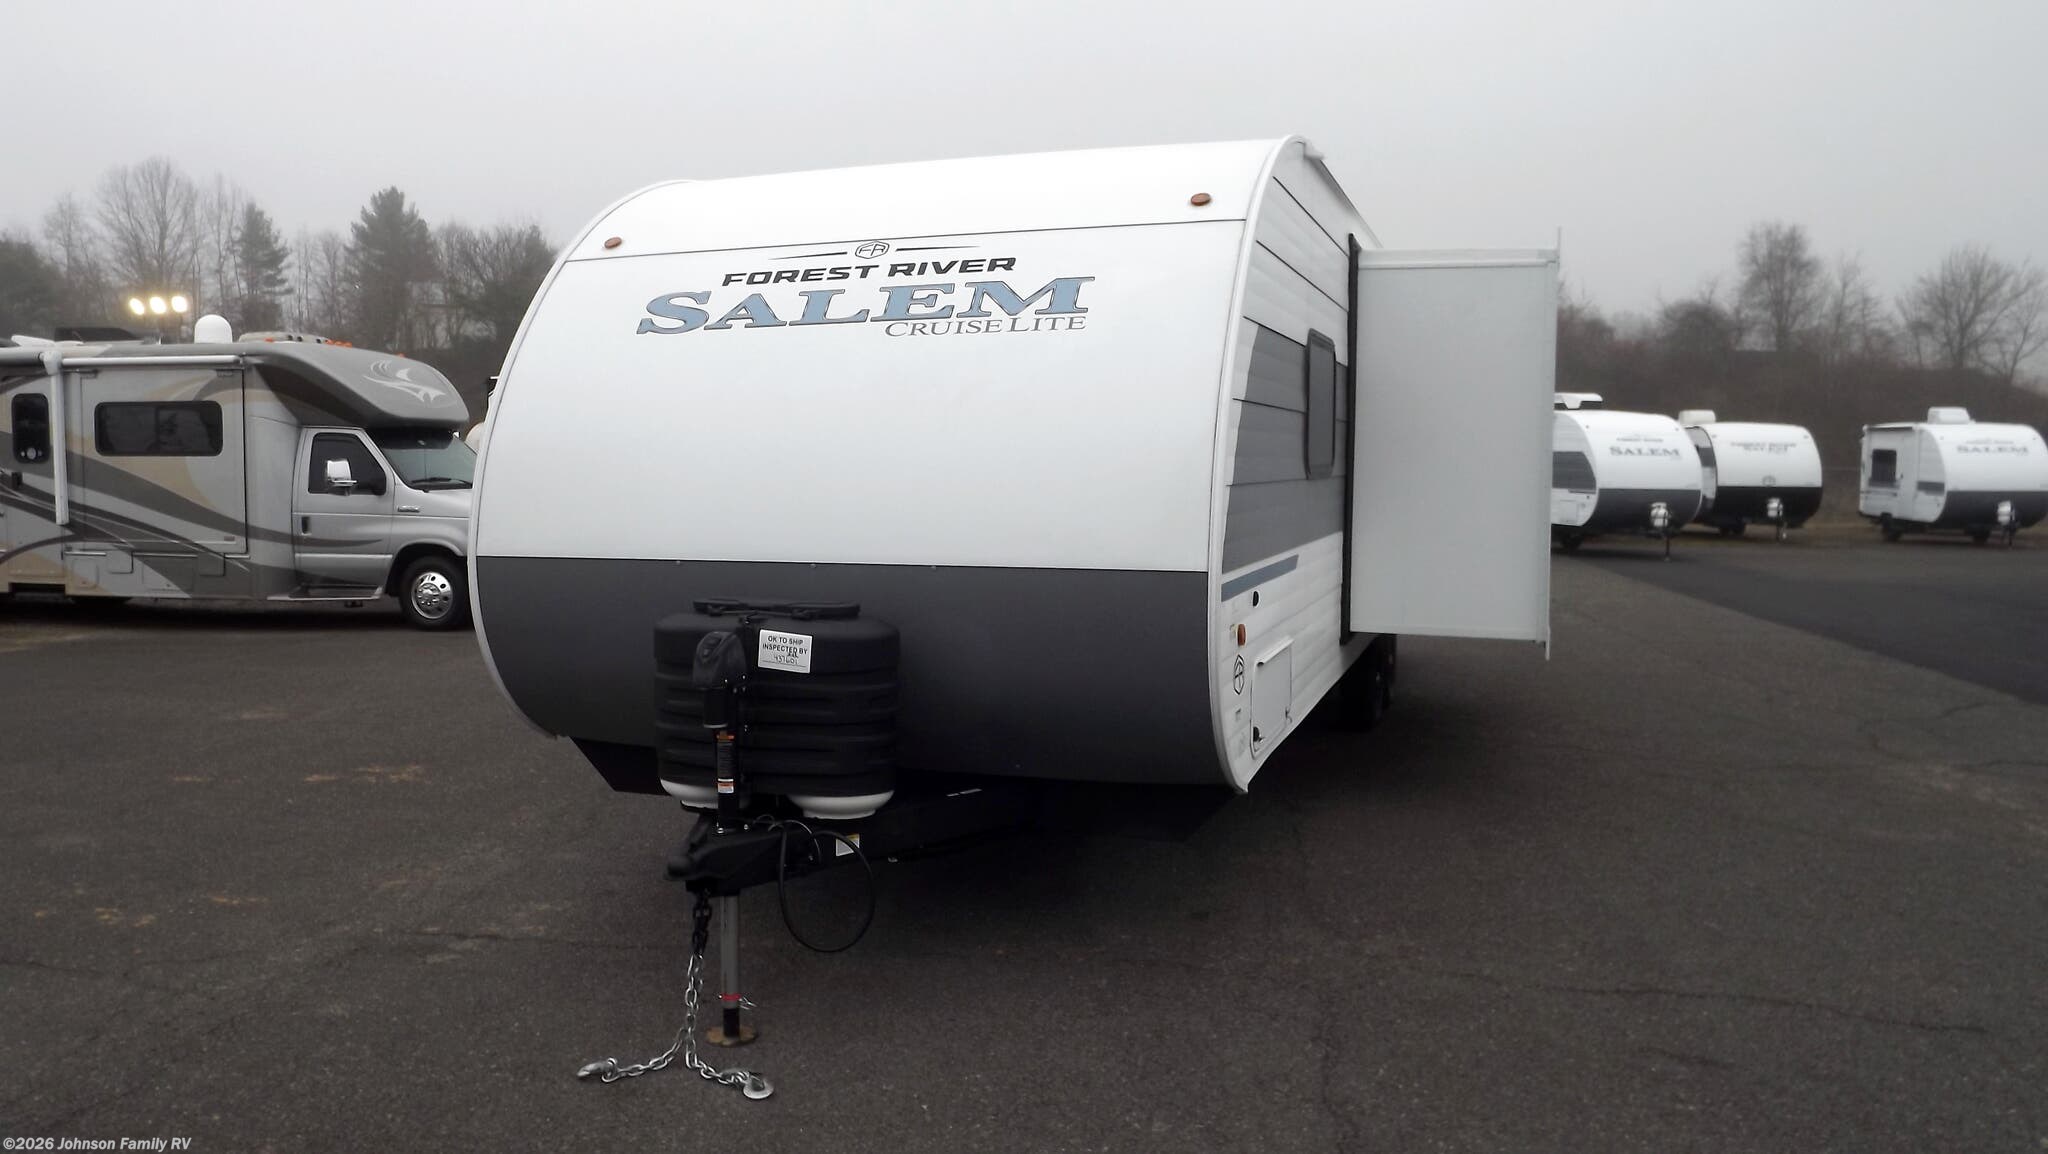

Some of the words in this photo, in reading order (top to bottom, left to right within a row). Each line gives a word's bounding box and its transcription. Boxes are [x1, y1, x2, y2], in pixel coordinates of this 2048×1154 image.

[722, 265, 879, 286] FOREST
[888, 257, 1016, 277] RIVER
[636, 276, 1095, 335] SALEM
[763, 643, 798, 653] INSPECTED
[798, 647, 808, 655] BY
